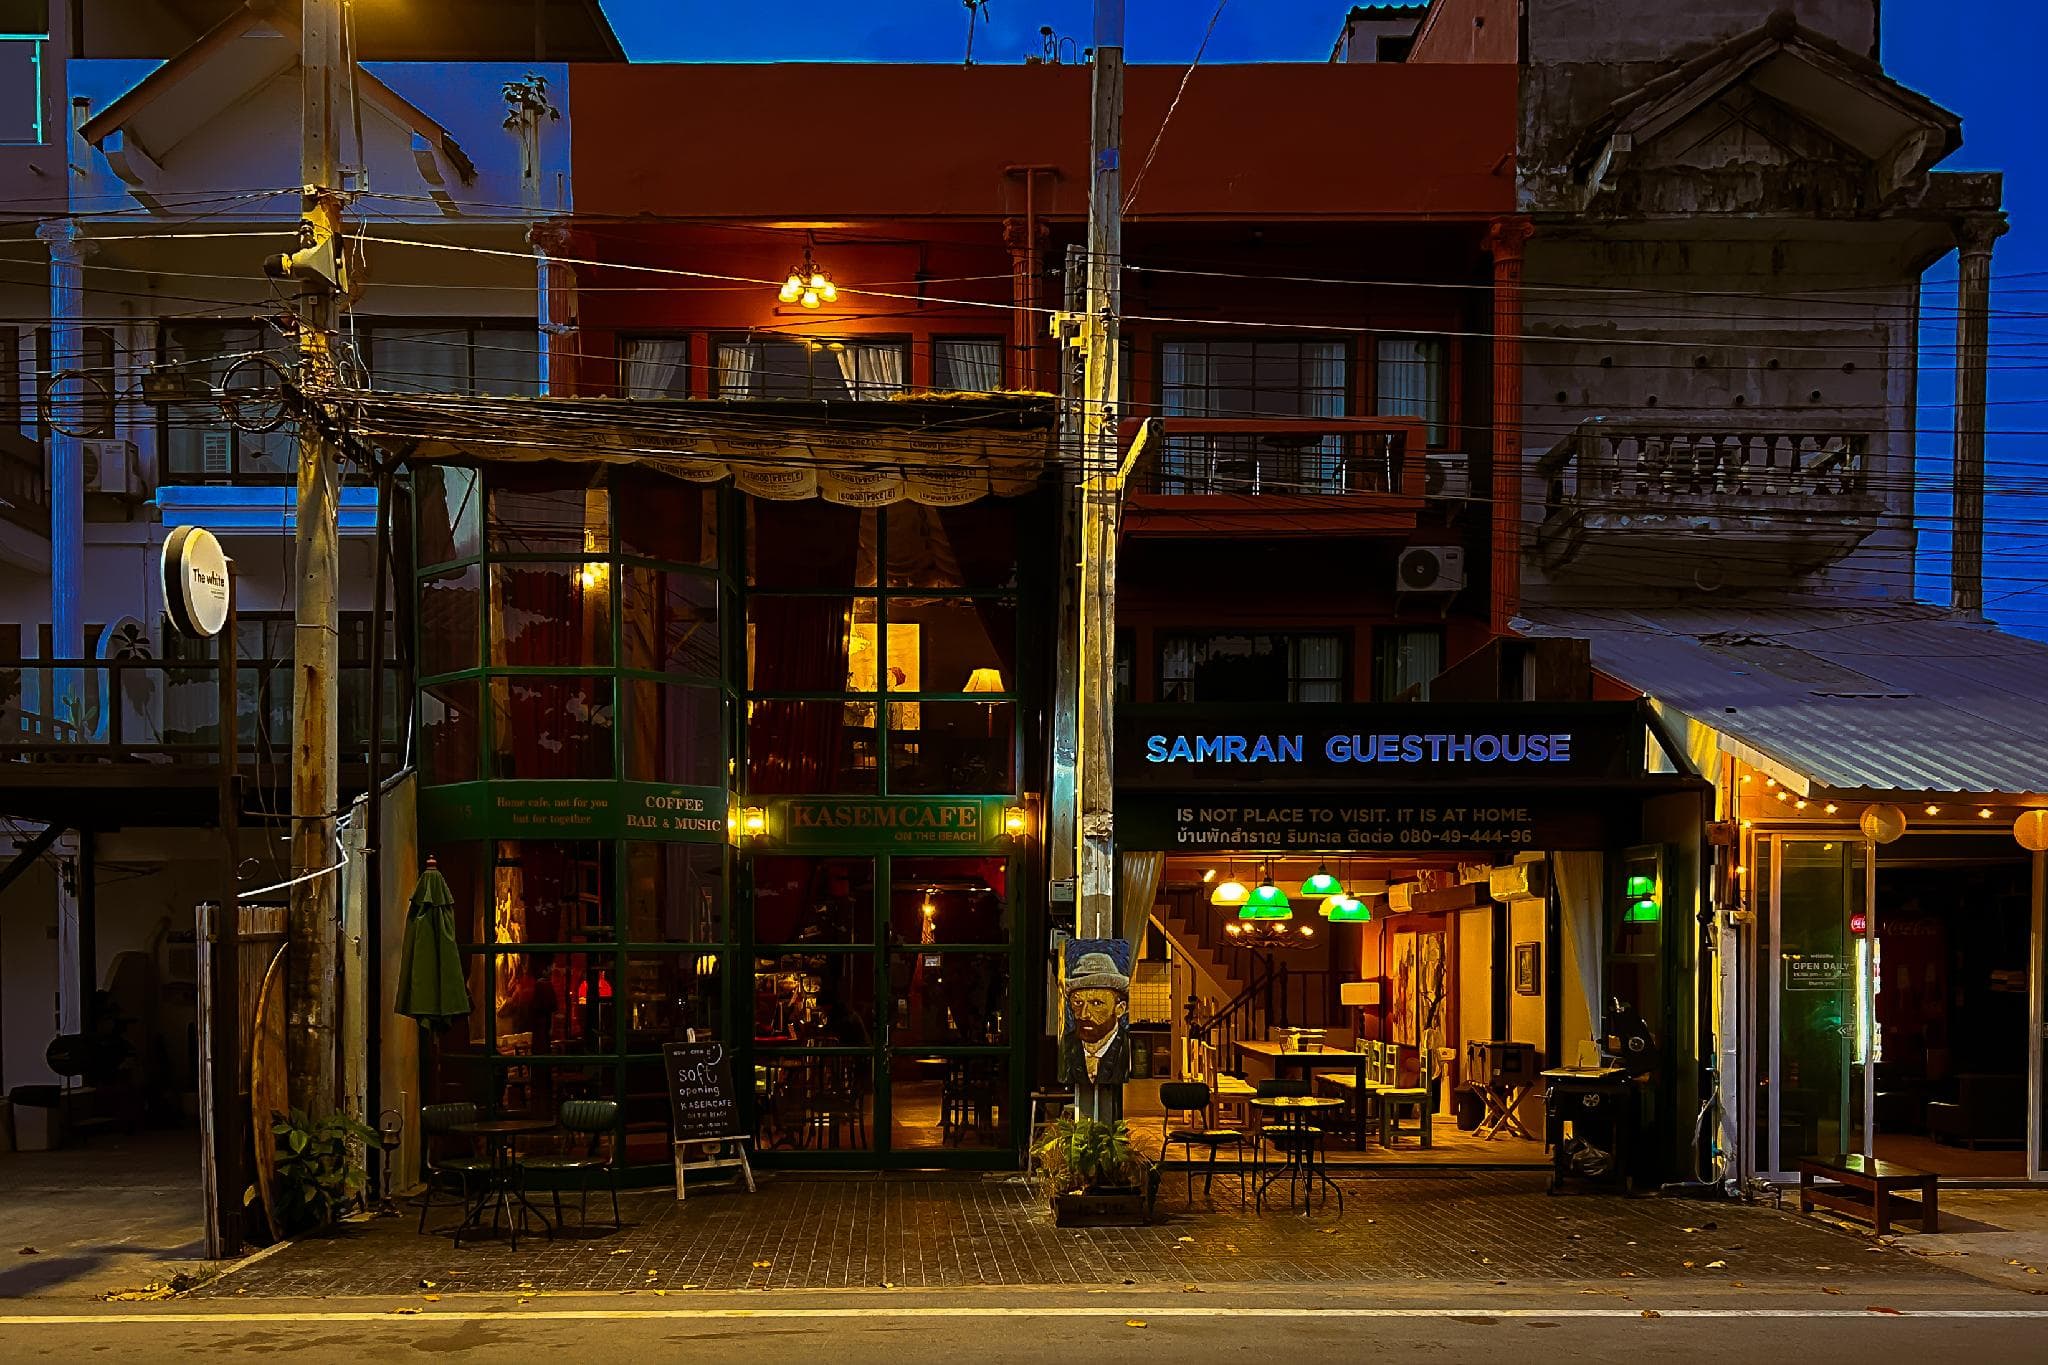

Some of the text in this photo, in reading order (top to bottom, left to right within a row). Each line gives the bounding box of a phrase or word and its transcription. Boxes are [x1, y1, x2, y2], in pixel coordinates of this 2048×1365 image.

[193, 568, 225, 587] The white
[1146, 733, 1571, 764] SAMRAN GUESTHOUSE
[496, 796, 525, 808] Home
[554, 798, 570, 808] not
[573, 797, 588, 808] for
[591, 799, 608, 810] you
[645, 795, 704, 812] COFFEE
[512, 813, 528, 824] but
[532, 814, 546, 824] for
[626, 814, 721, 832] BAR & MUSIC
[793, 806, 977, 828] KASEMCAFE
[1177, 808, 1533, 823] IS NOT PLACE TO VISIT. IT IS AT HOME.
[895, 831, 976, 841] ON THE BEACH
[1177, 827, 1281, 845] บ้านพักสำราญ
[1287, 828, 1342, 843] ริมทะเล
[1399, 829, 1532, 844] 080-49-444-96
[1793, 962, 1849, 970] OPEN DAILY
[679, 1086, 720, 1097] opening
